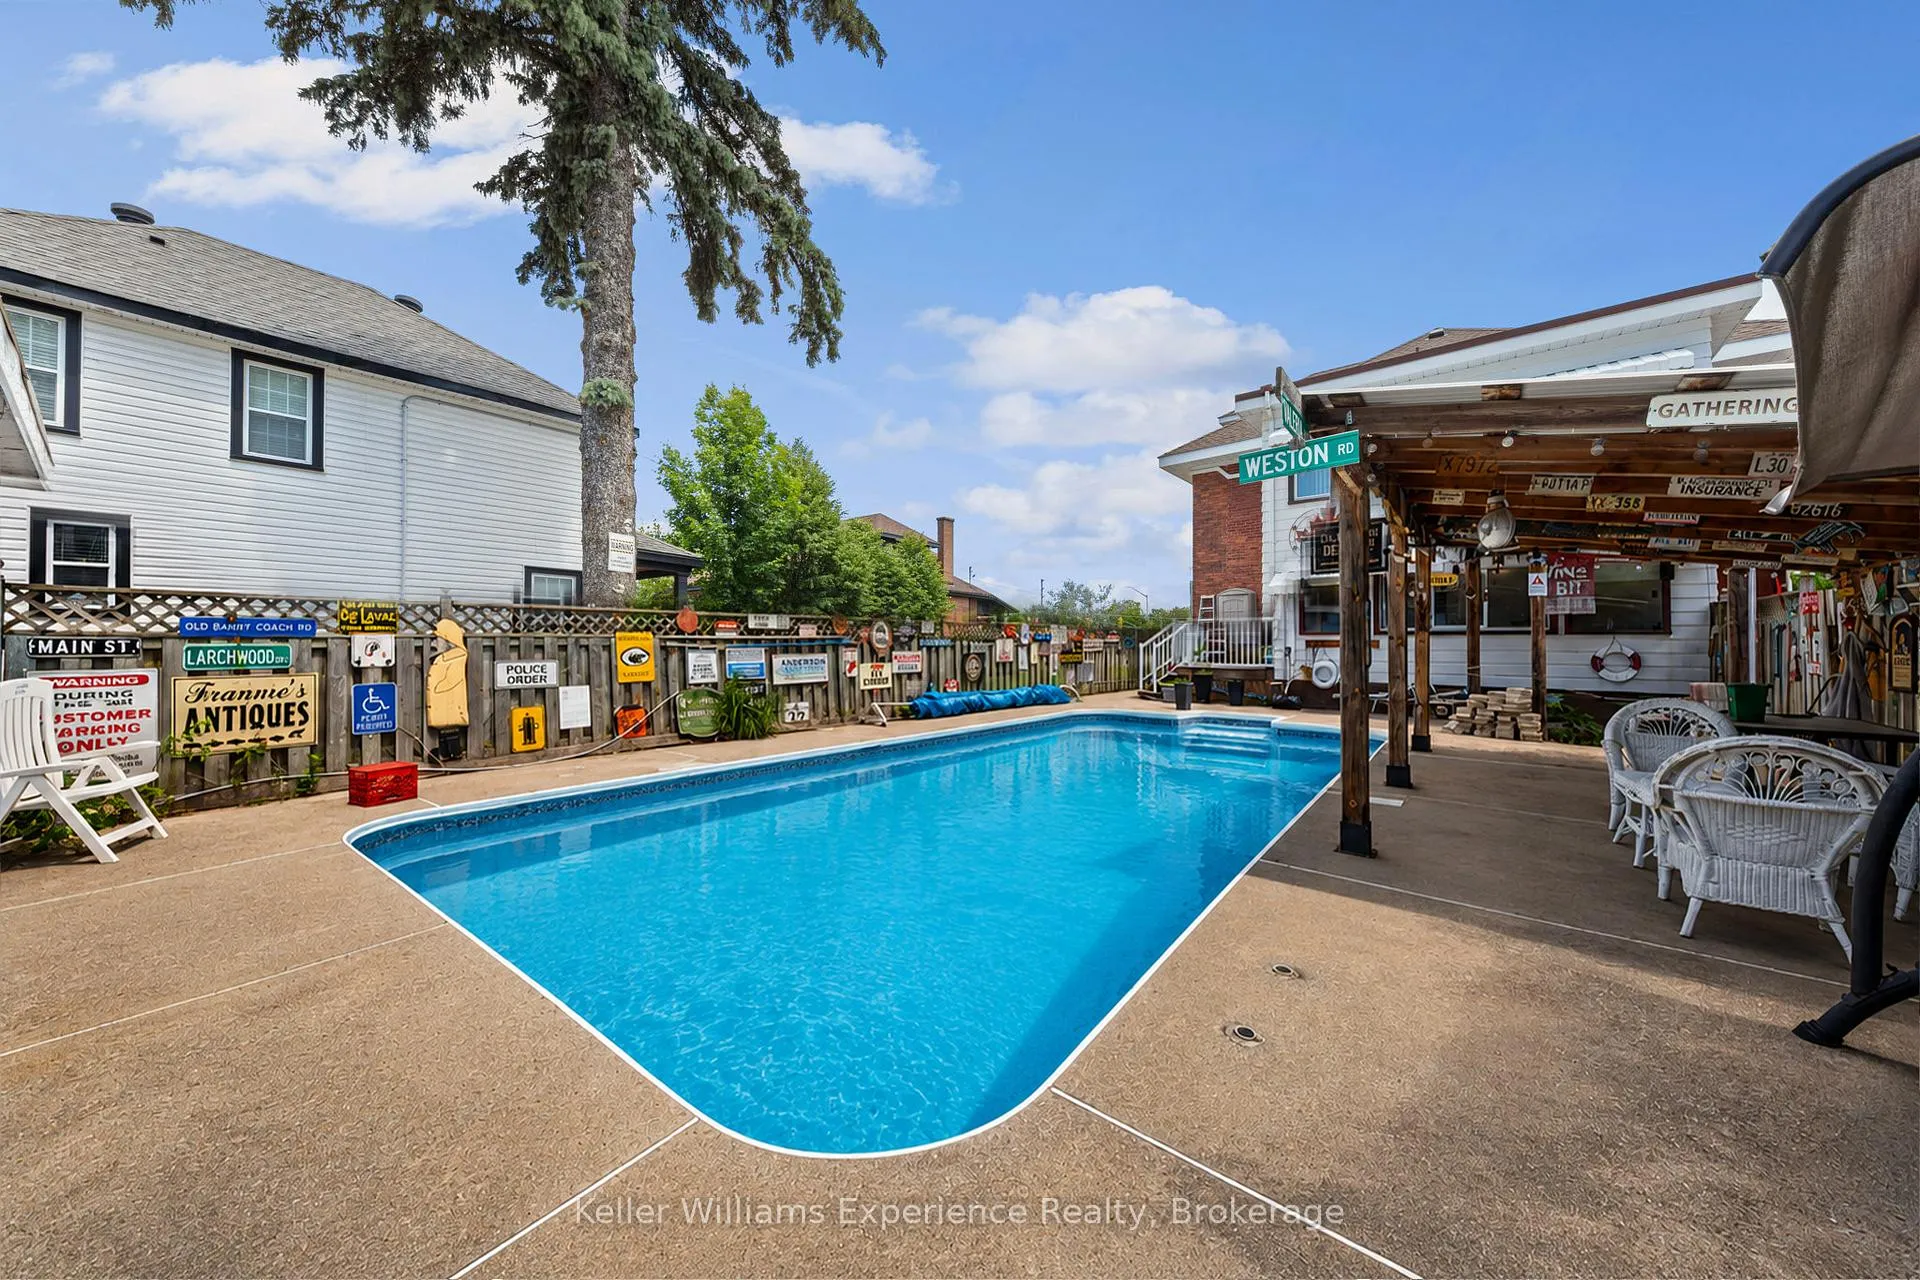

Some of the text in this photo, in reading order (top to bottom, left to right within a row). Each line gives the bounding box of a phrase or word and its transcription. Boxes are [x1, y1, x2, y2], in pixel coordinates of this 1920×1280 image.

[1658, 397, 1796, 418] GATHERING
[1245, 442, 1354, 478] WESTON RD
[1680, 485, 1763, 497] INSURANCE
[185, 622, 208, 631] OLD
[256, 623, 293, 631] COACH
[38, 640, 136, 654] MAIN ST.
[187, 649, 274, 665] LARCHWOOD
[506, 675, 547, 684] ORDER
[54, 690, 133, 700] DURING
[184, 701, 309, 735] ANTIQUES
[54, 723, 141, 737] ARKING
